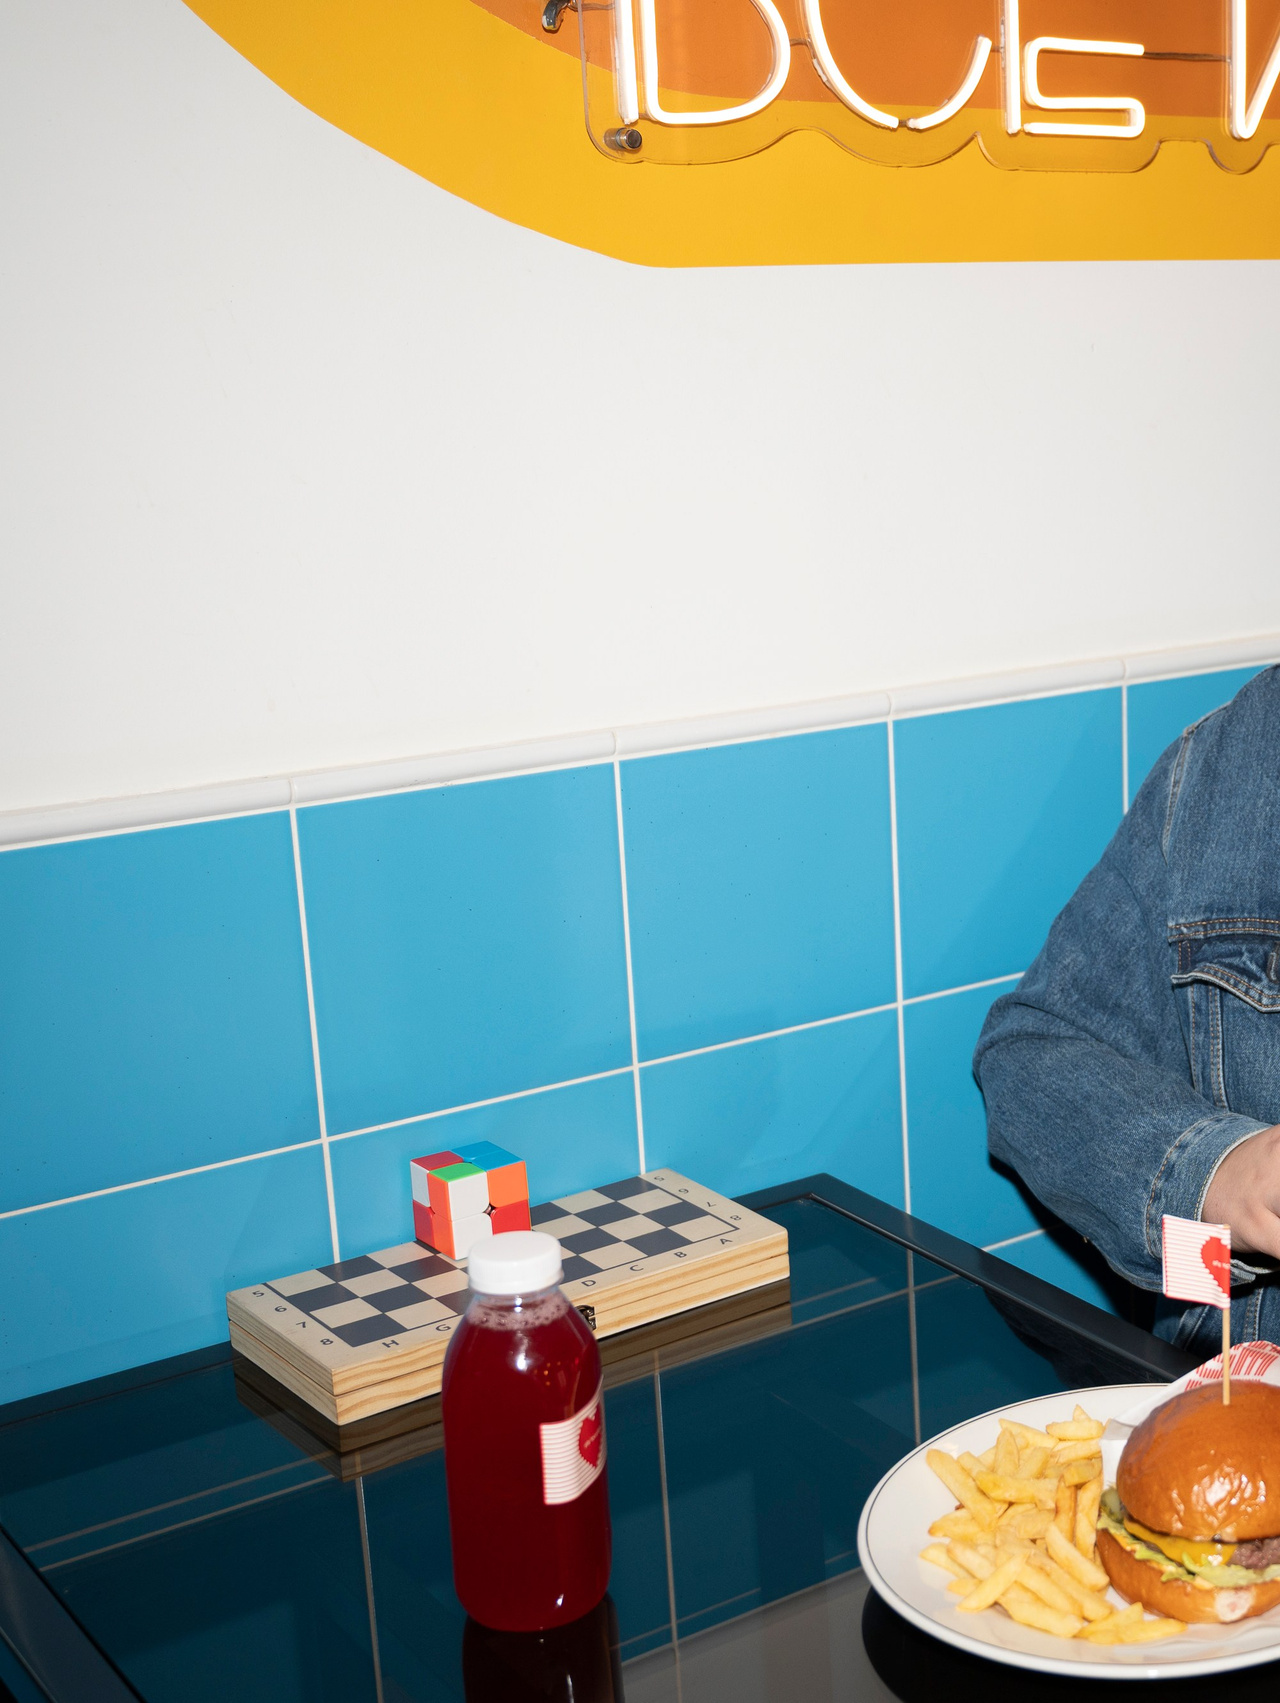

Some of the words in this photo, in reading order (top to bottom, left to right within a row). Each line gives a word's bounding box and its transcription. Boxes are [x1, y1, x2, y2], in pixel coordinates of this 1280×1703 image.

[382, 1339, 399, 1348] H
[435, 1324, 451, 1332] G
[581, 1279, 596, 1287] D
[674, 1251, 687, 1259] B
[719, 1237, 733, 1245] A
[296, 1321, 307, 1329] 7
